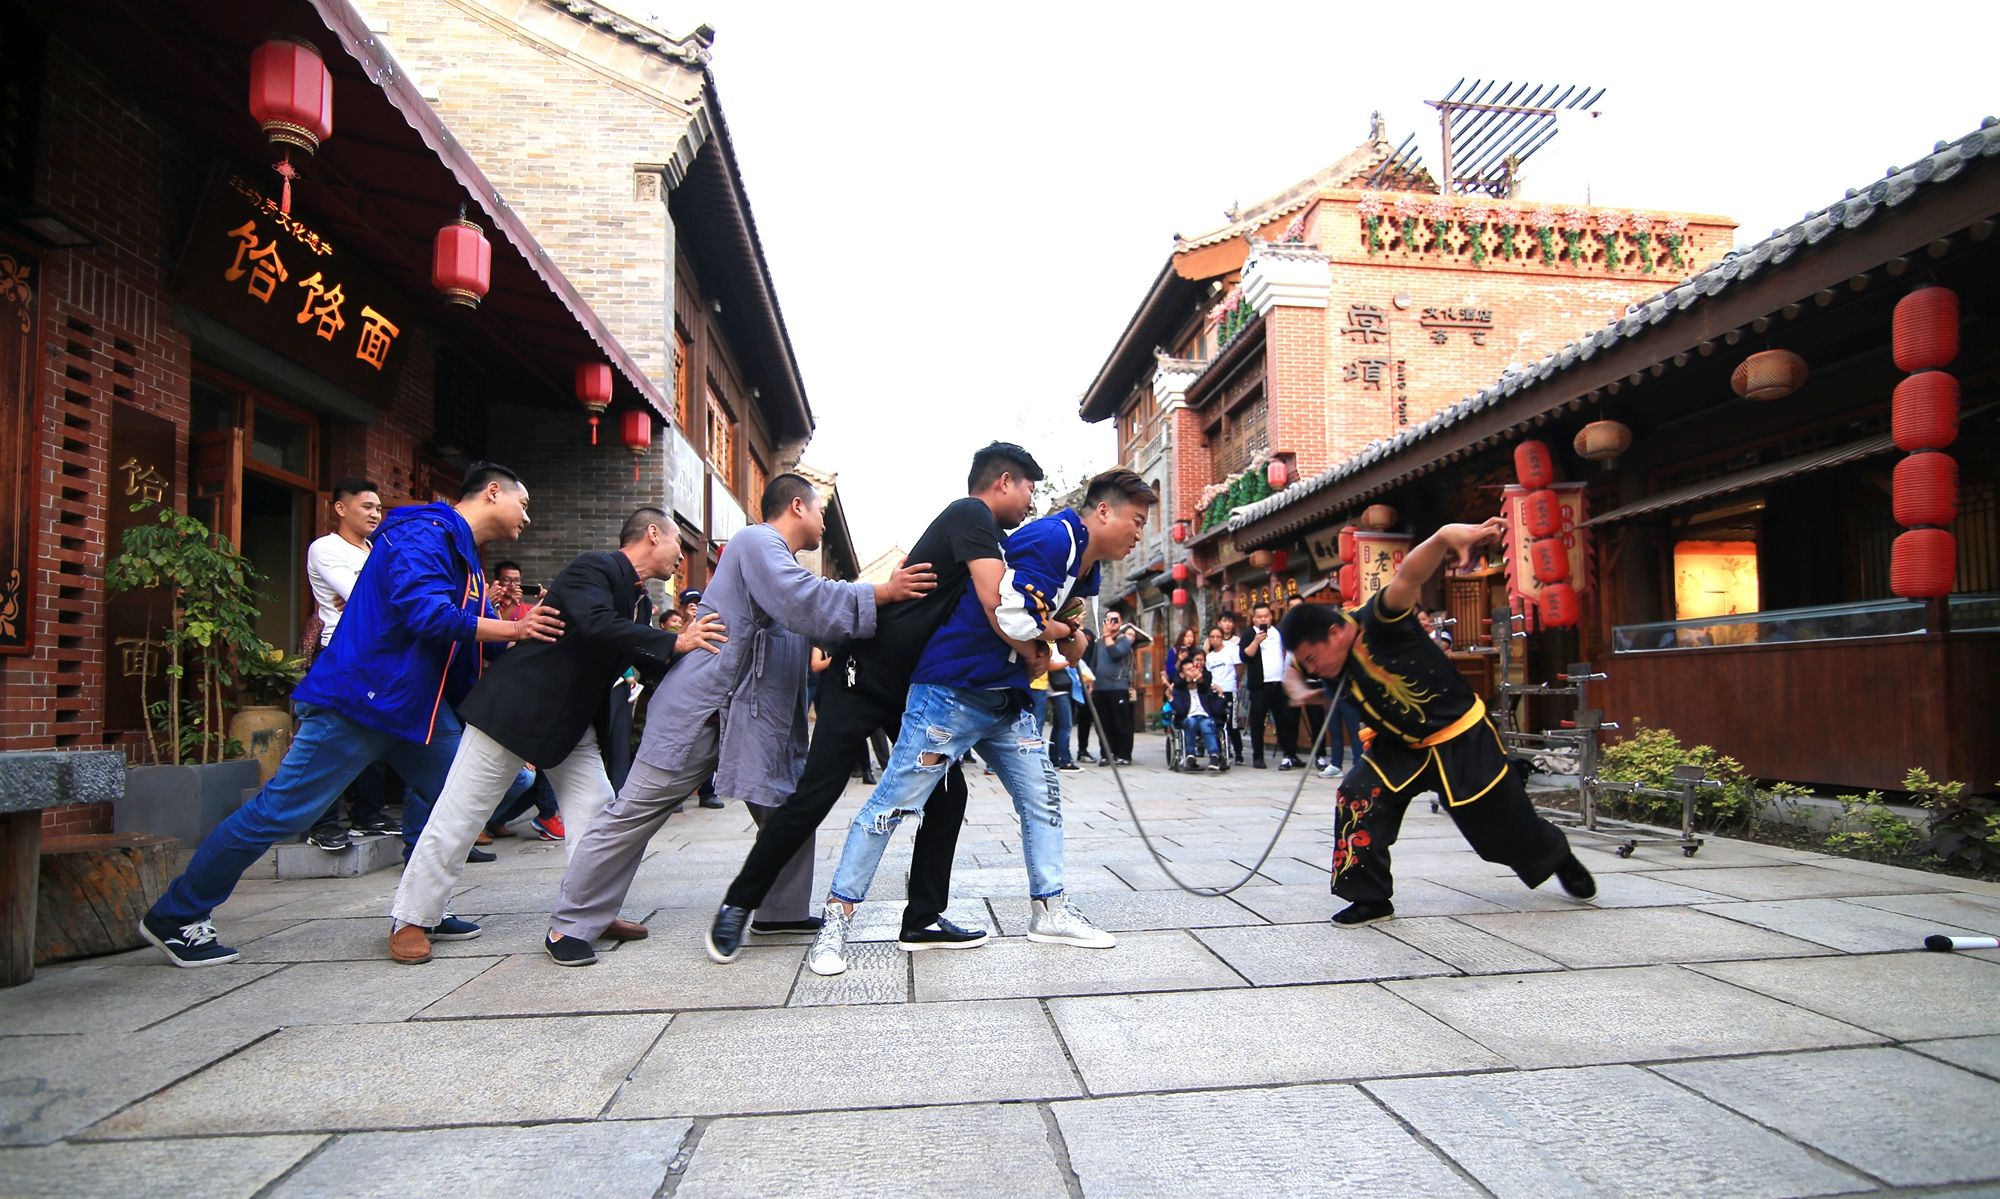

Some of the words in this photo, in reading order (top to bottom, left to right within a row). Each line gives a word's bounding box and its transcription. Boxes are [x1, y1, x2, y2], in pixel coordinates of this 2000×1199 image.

[225, 219, 400, 371] 饸饹面
[1421, 307, 1493, 322] 文化酒店
[115, 457, 169, 677] 饸面
